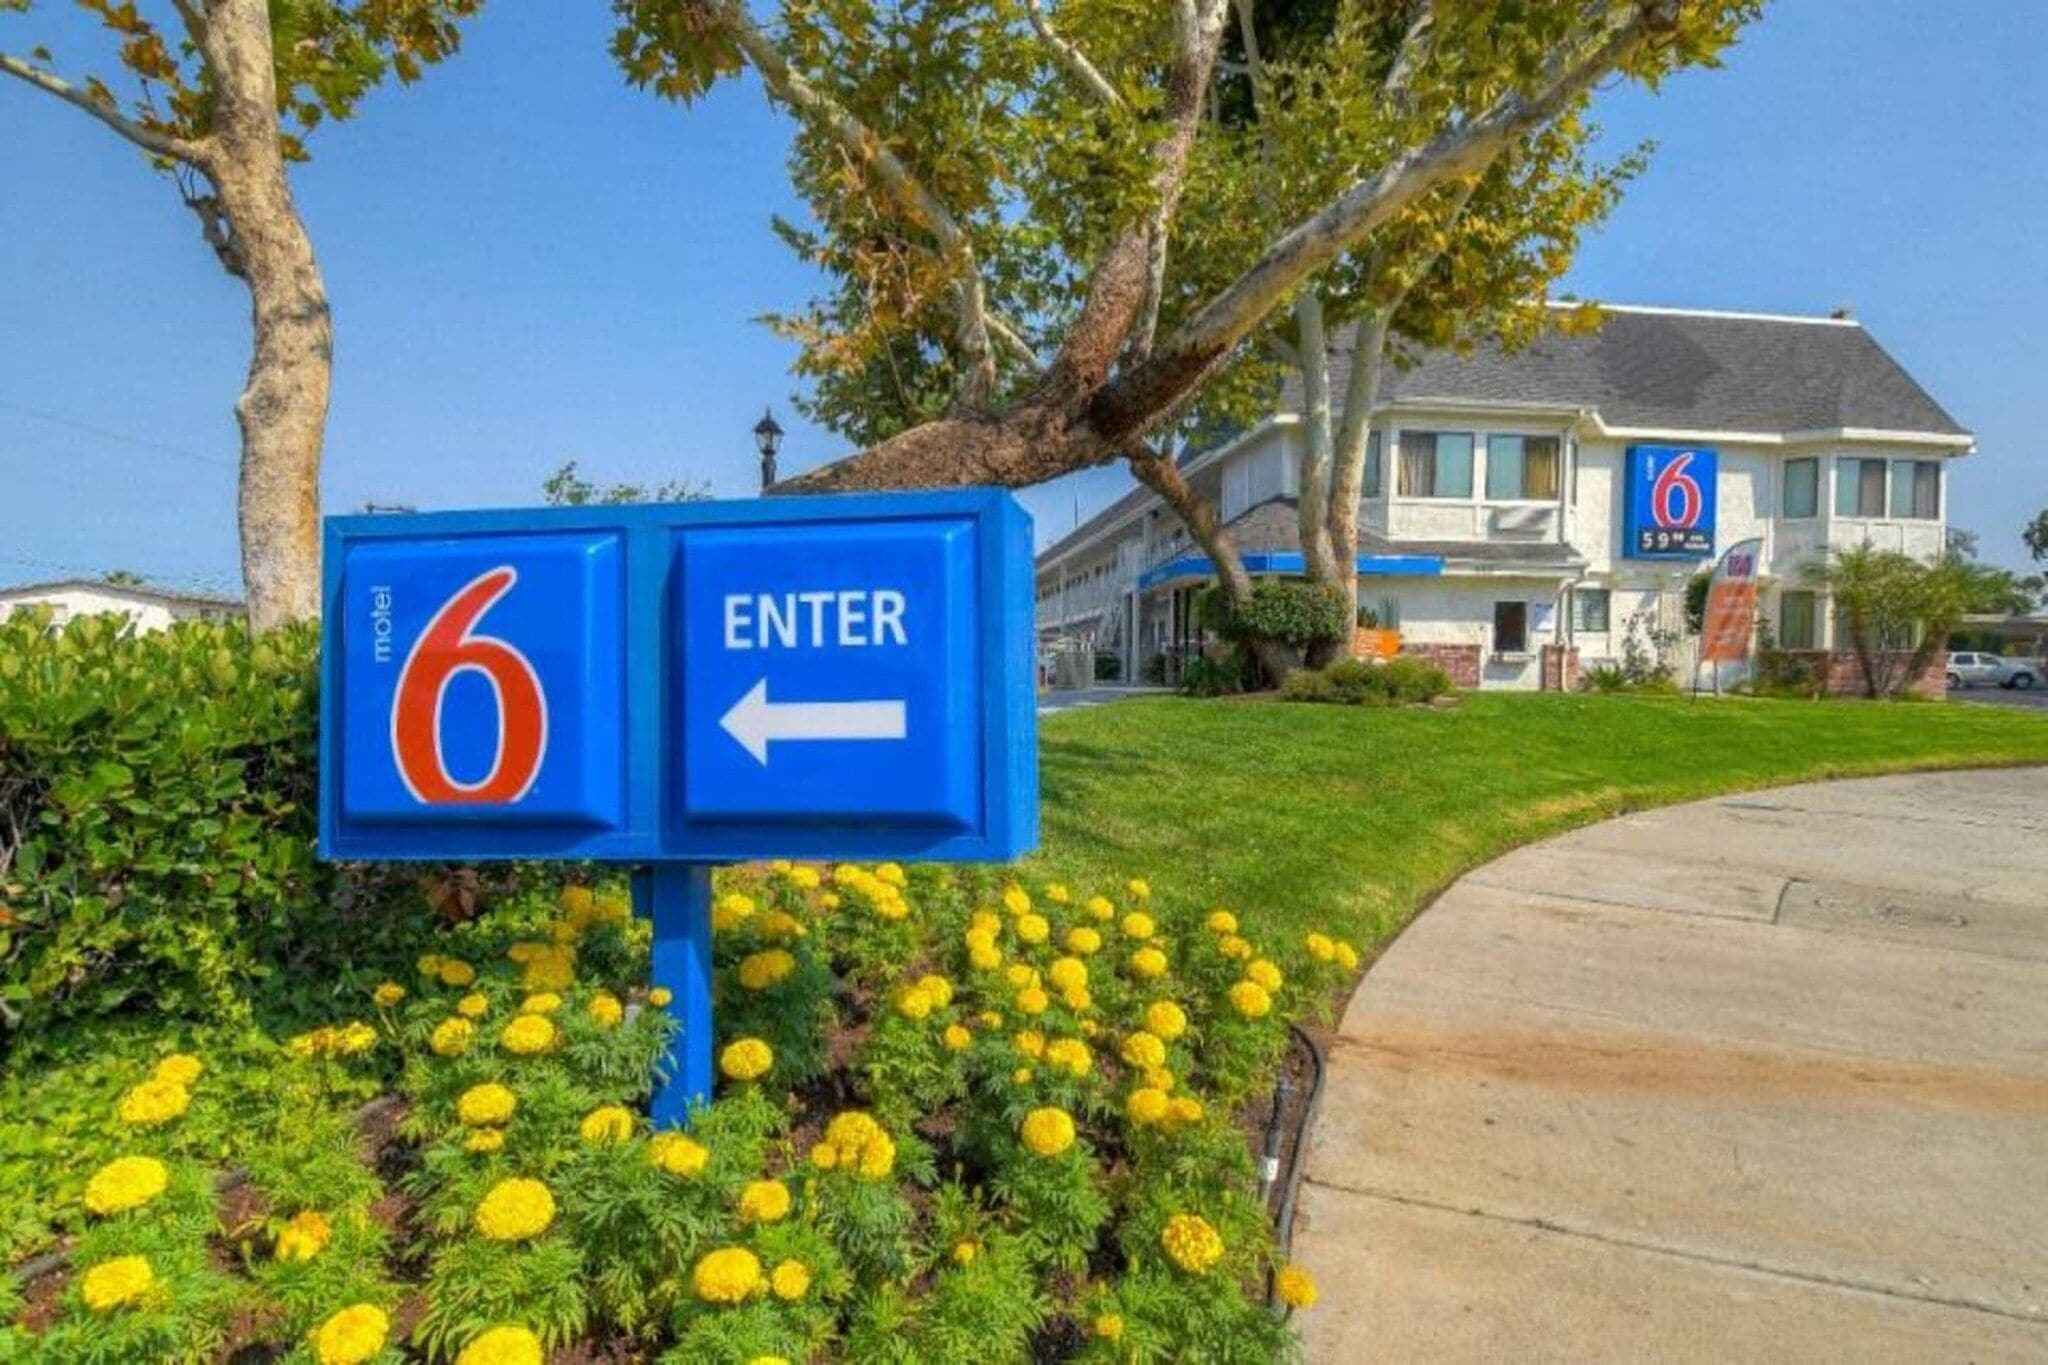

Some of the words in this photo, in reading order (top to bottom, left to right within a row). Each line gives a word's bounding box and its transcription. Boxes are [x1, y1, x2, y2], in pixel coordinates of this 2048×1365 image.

[1653, 452, 1701, 528] 6
[370, 585, 392, 663] motel
[724, 590, 909, 649] ENTER
[390, 566, 548, 804] 6
